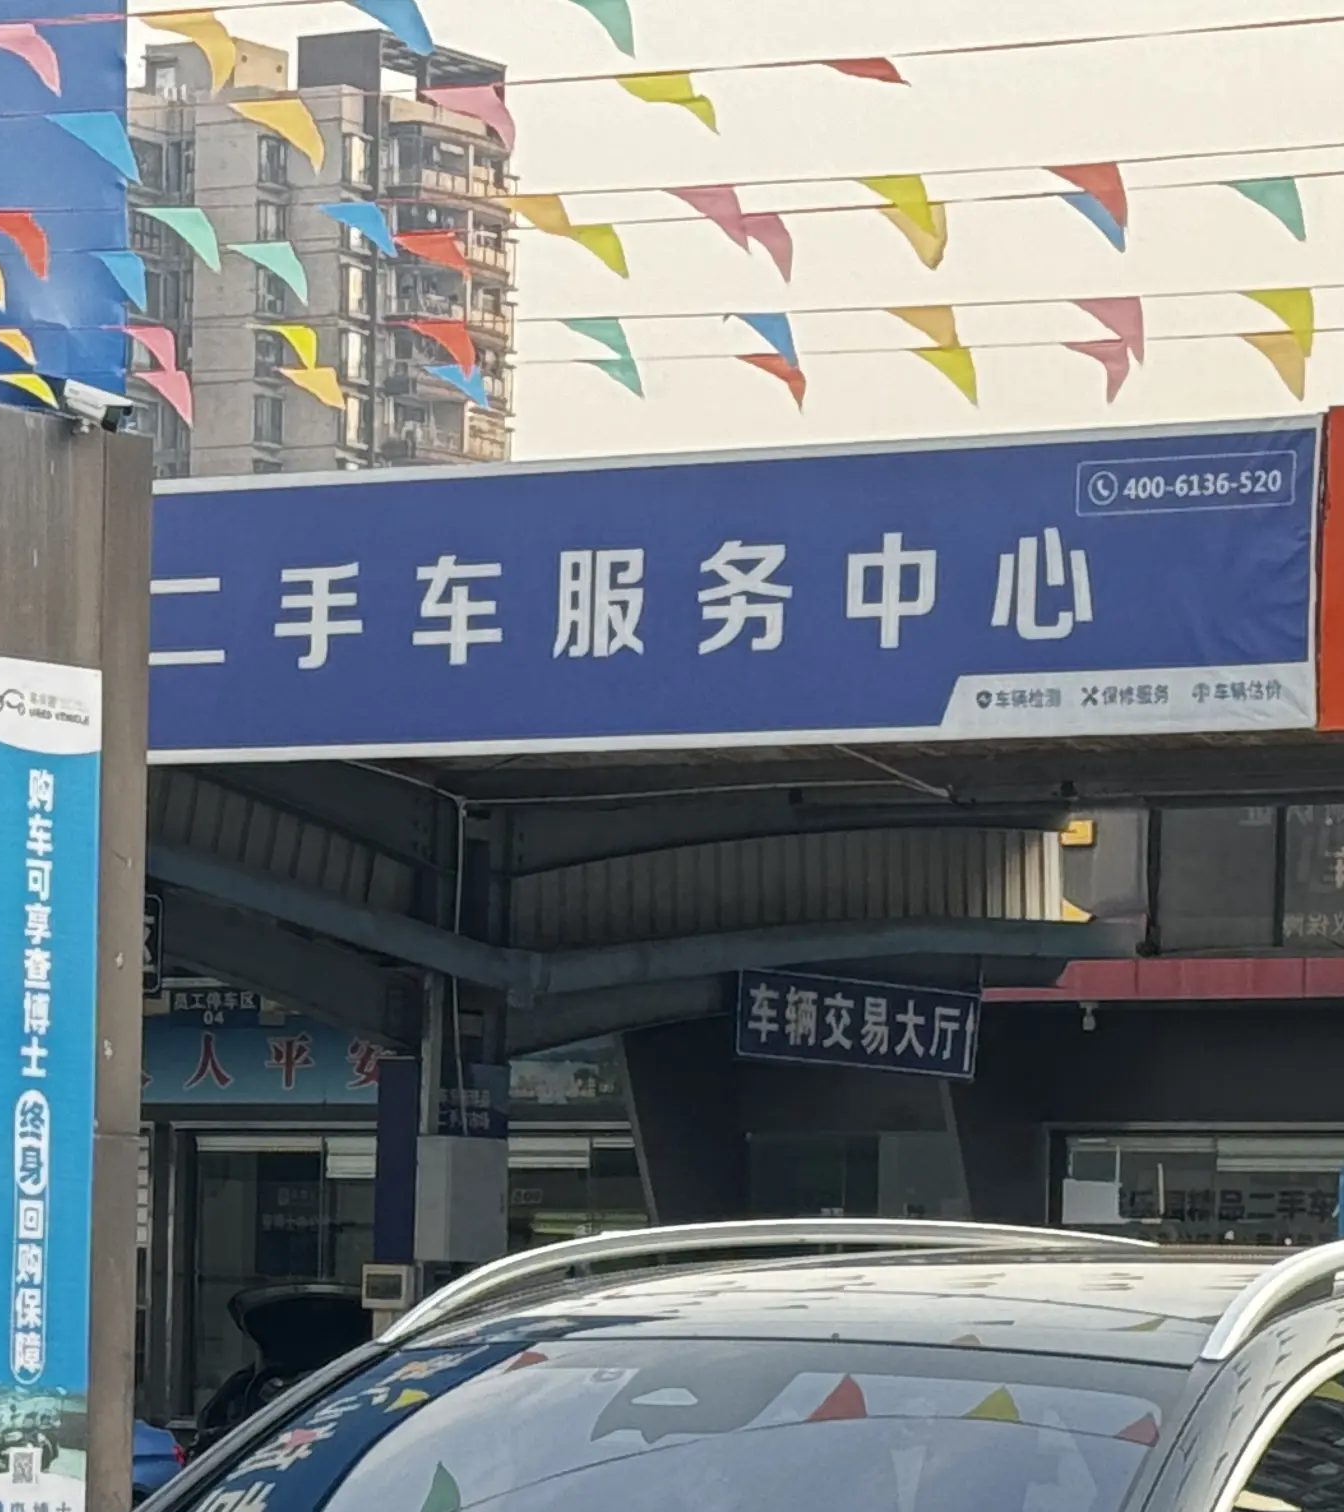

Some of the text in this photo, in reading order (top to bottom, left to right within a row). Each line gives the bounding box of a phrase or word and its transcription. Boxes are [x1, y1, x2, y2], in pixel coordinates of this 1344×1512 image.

[1122, 469, 1283, 501] 400-6136-520
[148, 526, 1093, 670] 二手车服务中心
[20, 768, 55, 1079] 购车可享查博士
[172, 989, 258, 1011] 员工停车区
[203, 1011, 225, 1026] 04
[746, 982, 962, 1061] 车辆交易大厅
